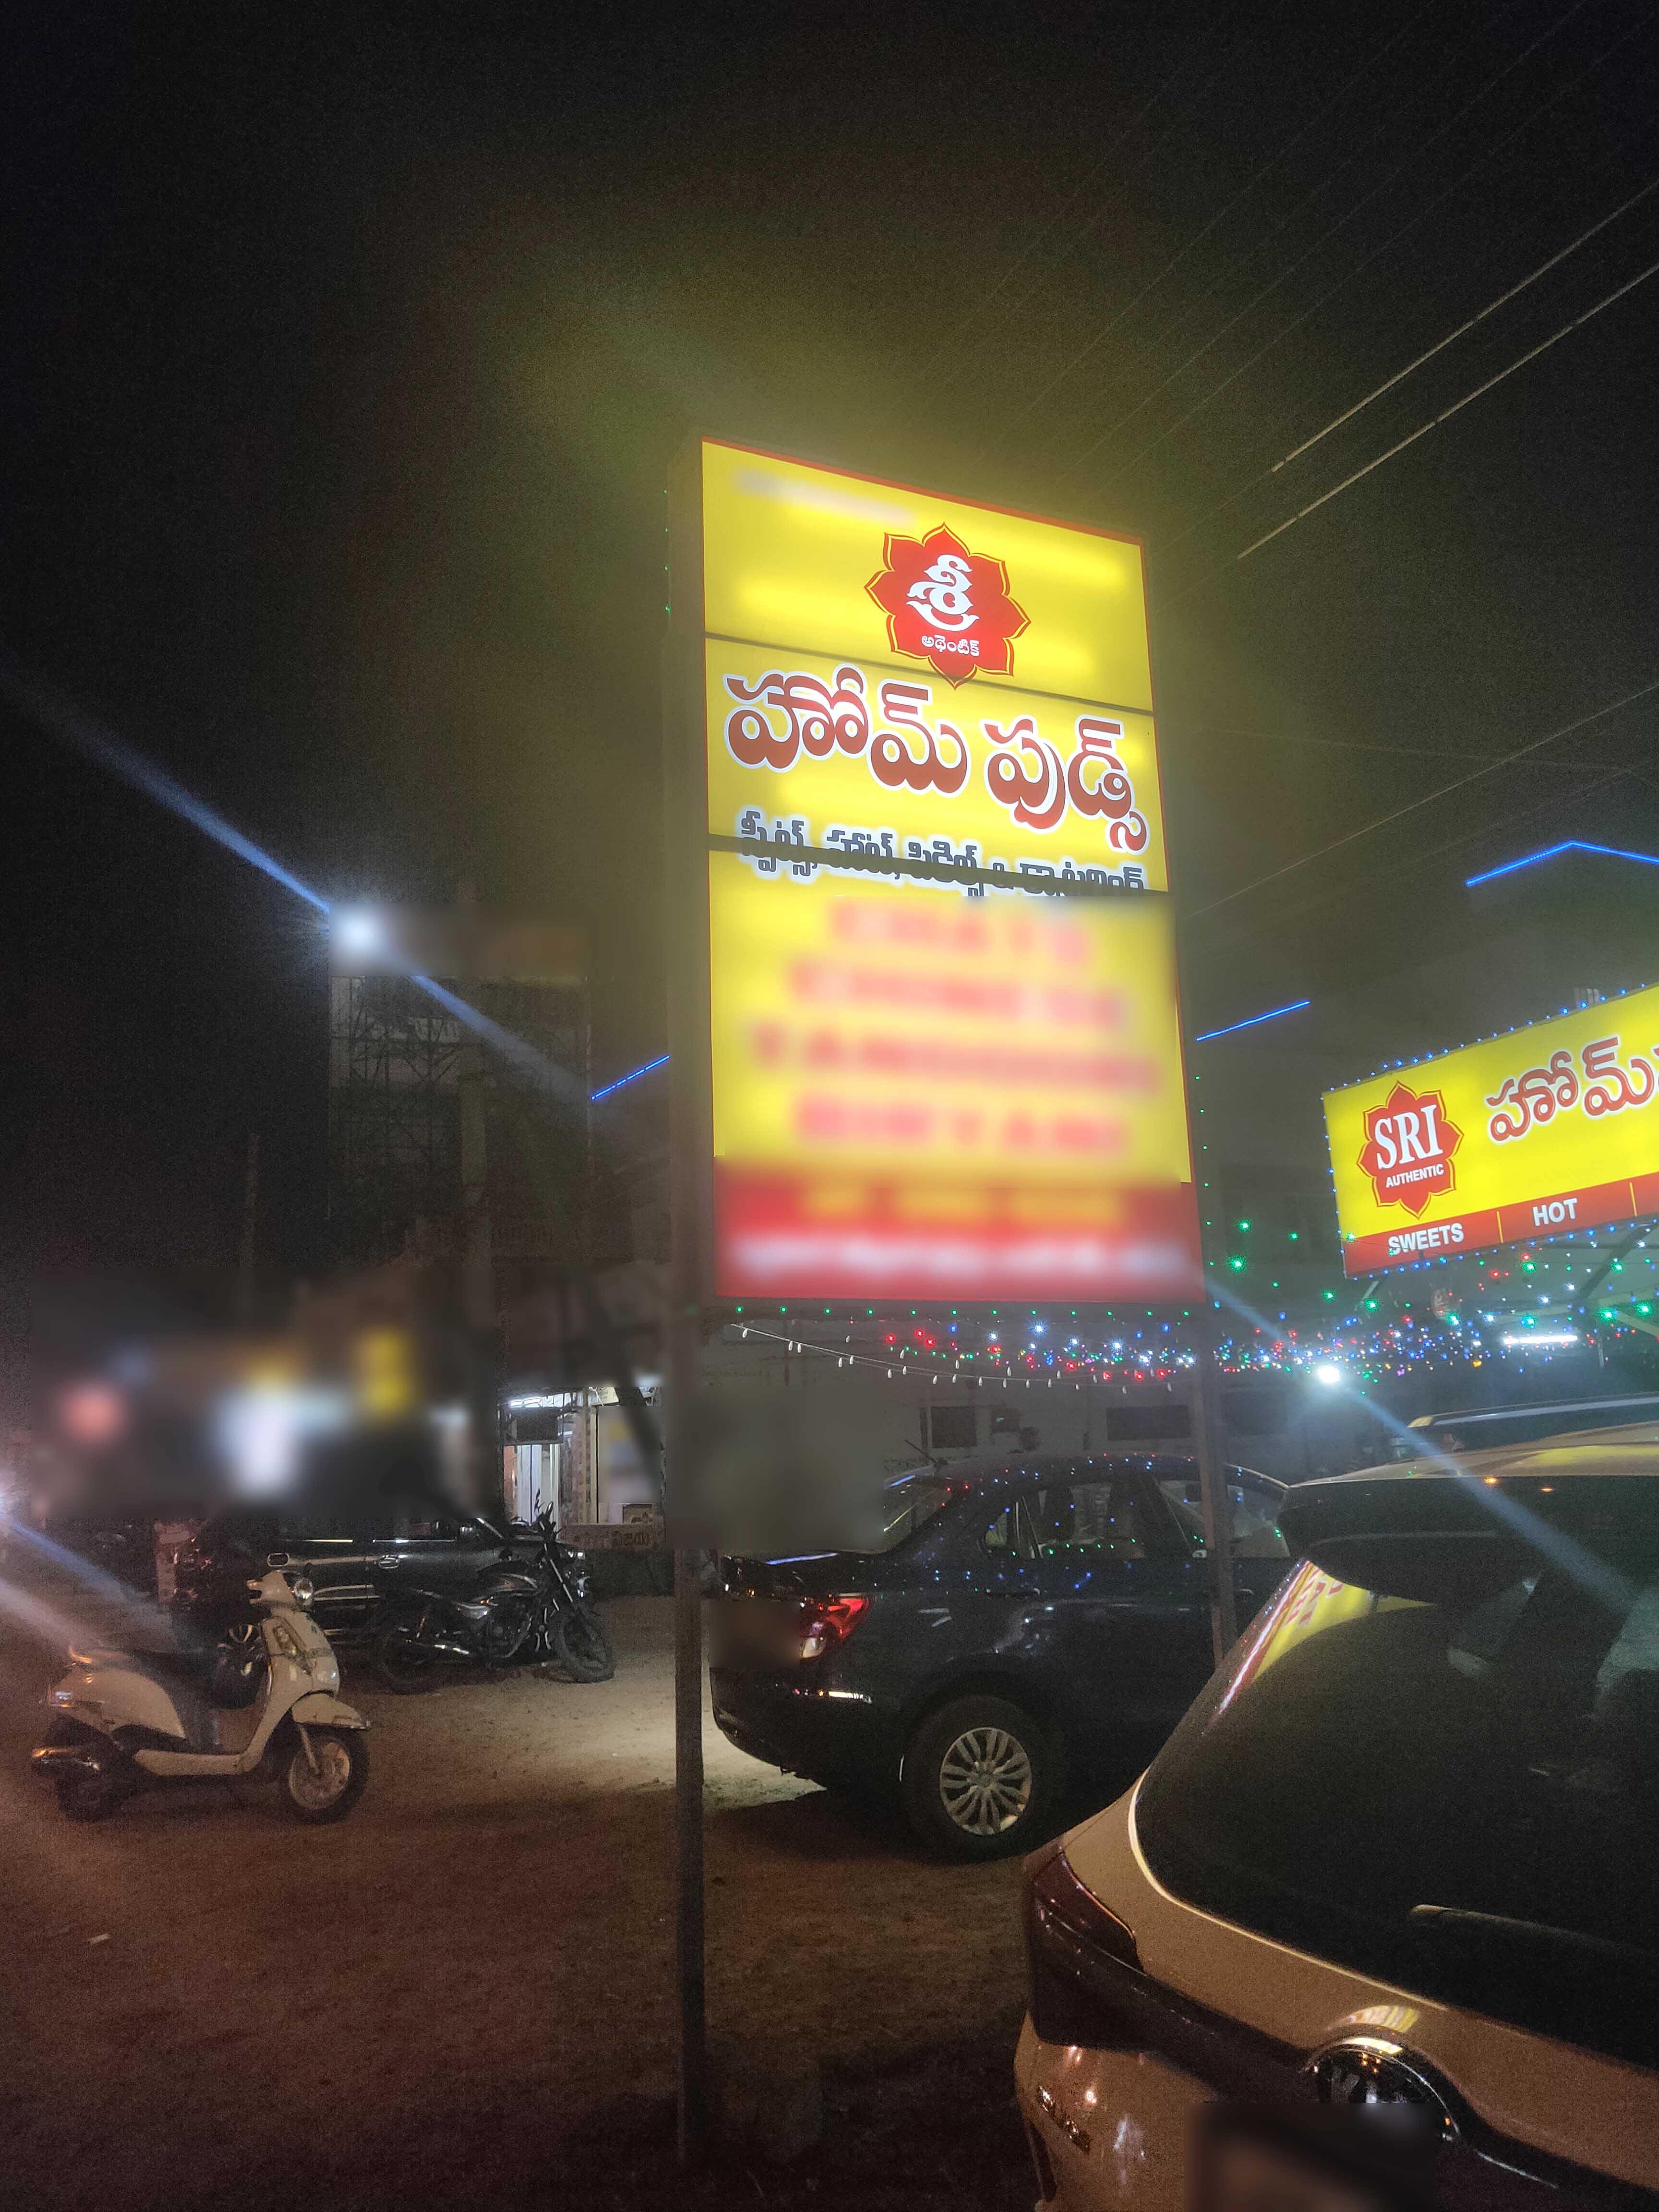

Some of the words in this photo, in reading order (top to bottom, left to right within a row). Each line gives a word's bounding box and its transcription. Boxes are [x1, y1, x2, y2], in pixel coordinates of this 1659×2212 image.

[906, 554, 980, 632] శ్రీ
[727, 667, 968, 794] హోమ్
[1486, 1036, 1655, 1142] హోమ్
[1374, 1104, 1443, 1169] SRI
[1386, 1164, 1444, 1188] AUTHENTIC
[1388, 1223, 1465, 1256] SWEETS
[1532, 1198, 1578, 1226] HOT
